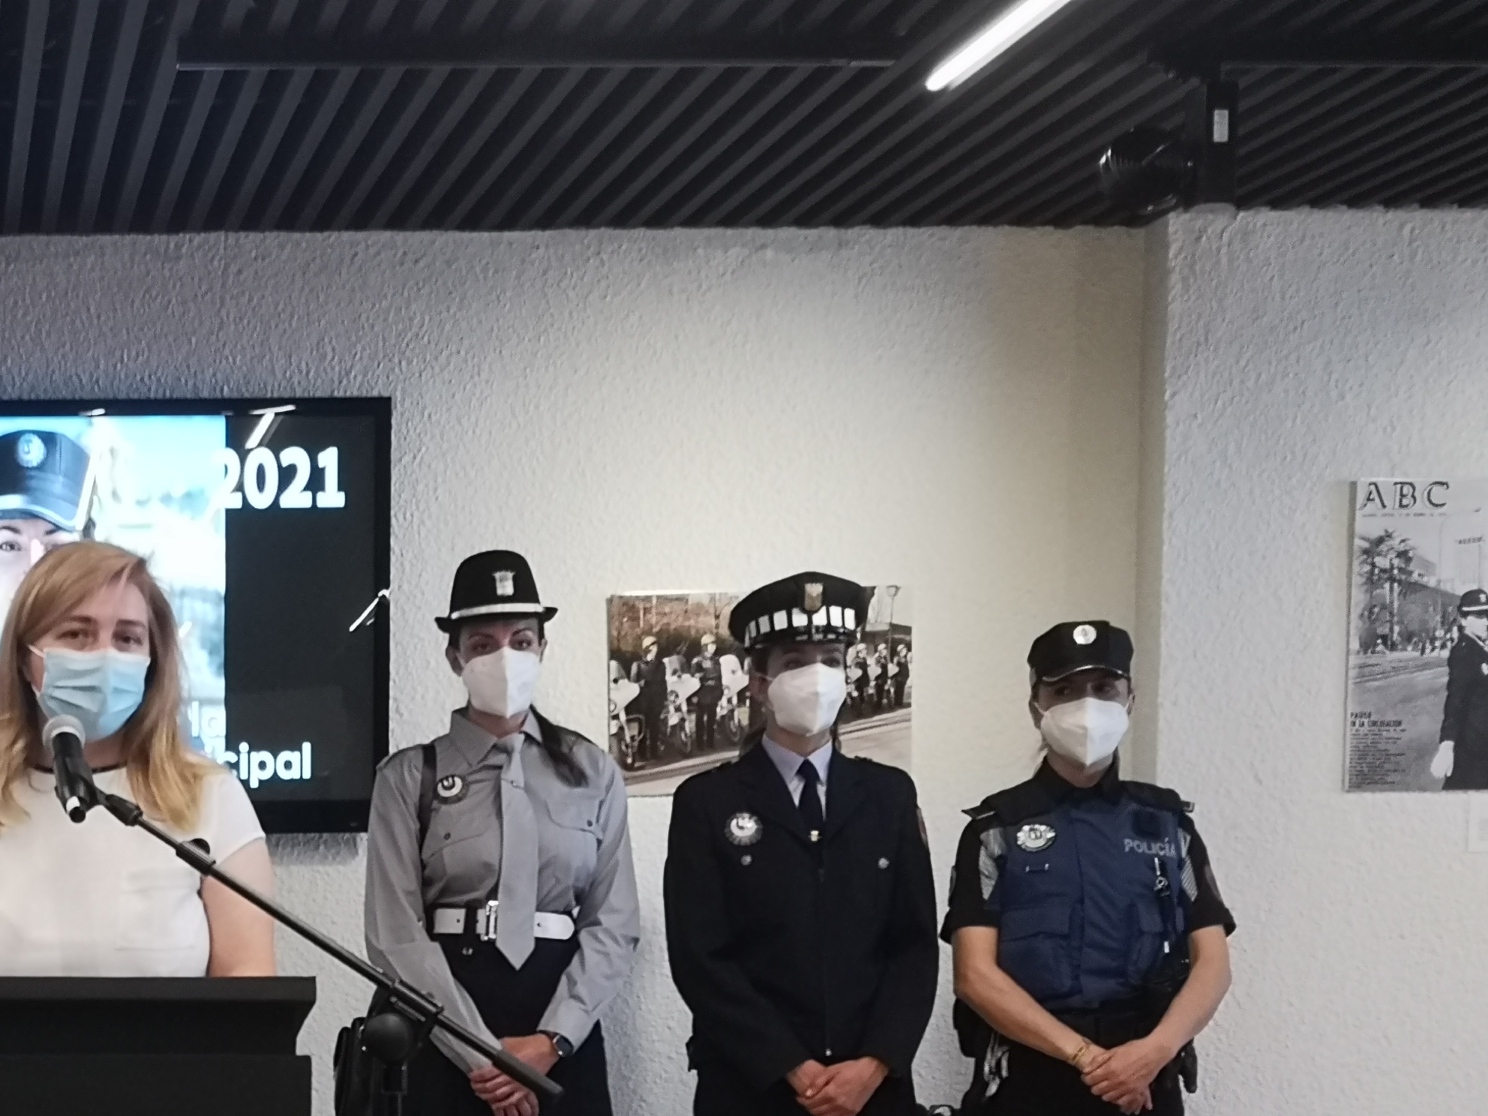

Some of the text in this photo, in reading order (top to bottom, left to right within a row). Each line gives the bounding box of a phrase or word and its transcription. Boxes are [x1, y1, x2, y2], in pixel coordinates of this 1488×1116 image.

[212, 446, 346, 510] 2021
[1358, 481, 1450, 511] ABC
[216, 741, 312, 789] cipal
